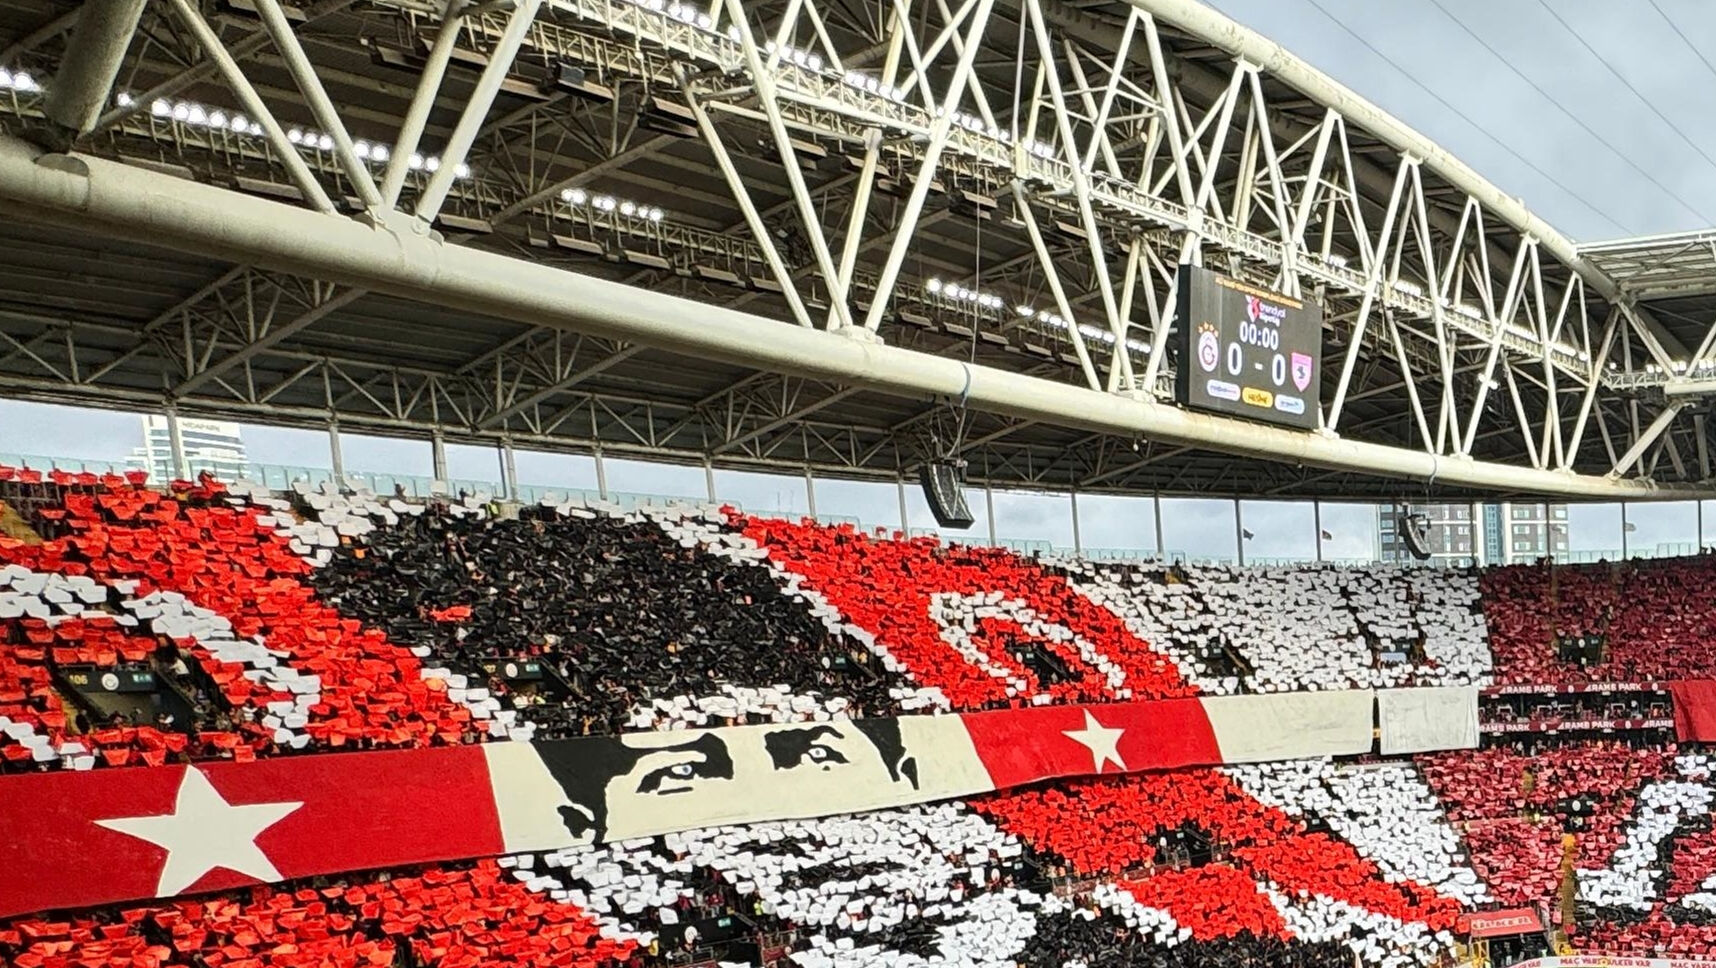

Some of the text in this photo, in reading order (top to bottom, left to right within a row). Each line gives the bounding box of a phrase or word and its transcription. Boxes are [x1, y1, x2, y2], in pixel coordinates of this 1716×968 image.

[1239, 320, 1279, 350] 00:00
[1227, 341, 1243, 376] 0
[1271, 353, 1286, 387] 0
